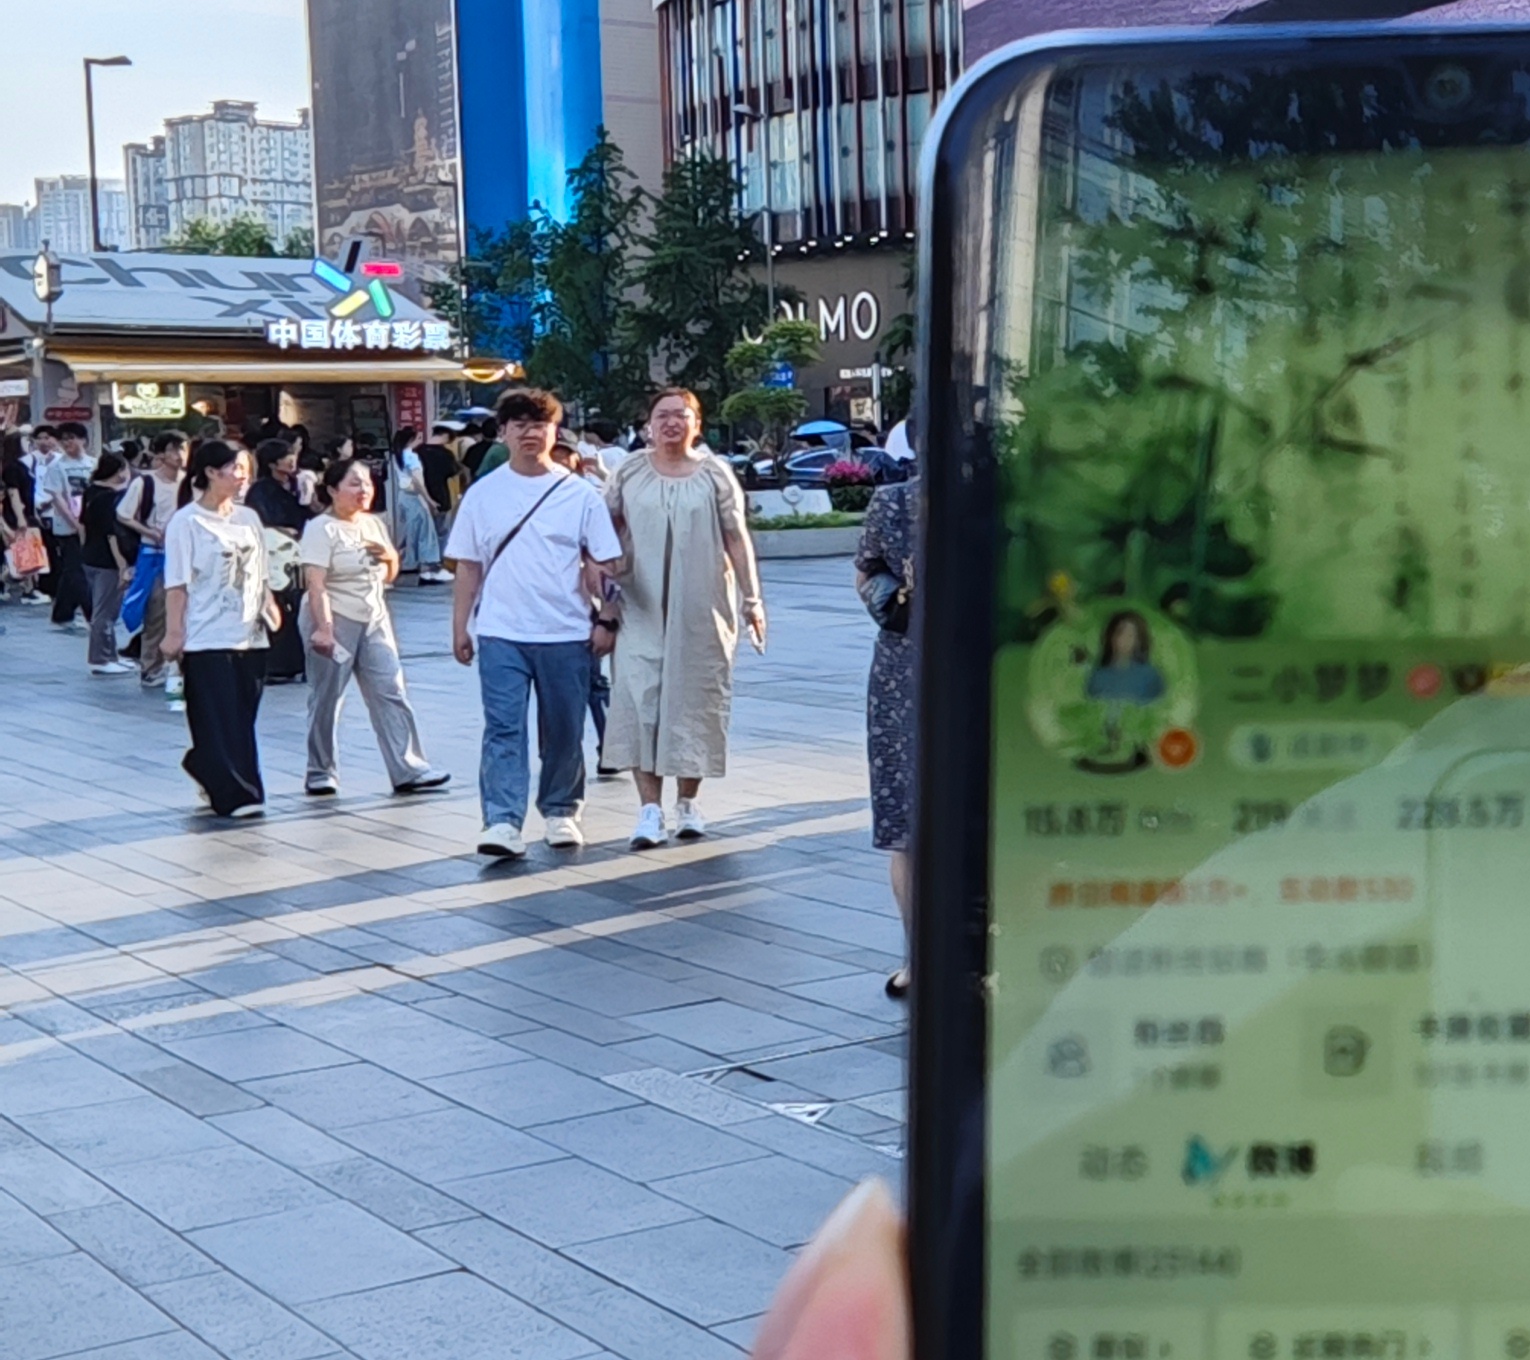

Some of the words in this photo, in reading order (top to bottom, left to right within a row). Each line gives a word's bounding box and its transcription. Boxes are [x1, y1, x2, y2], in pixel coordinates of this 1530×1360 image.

[267, 318, 451, 350] 中国体育彩票
